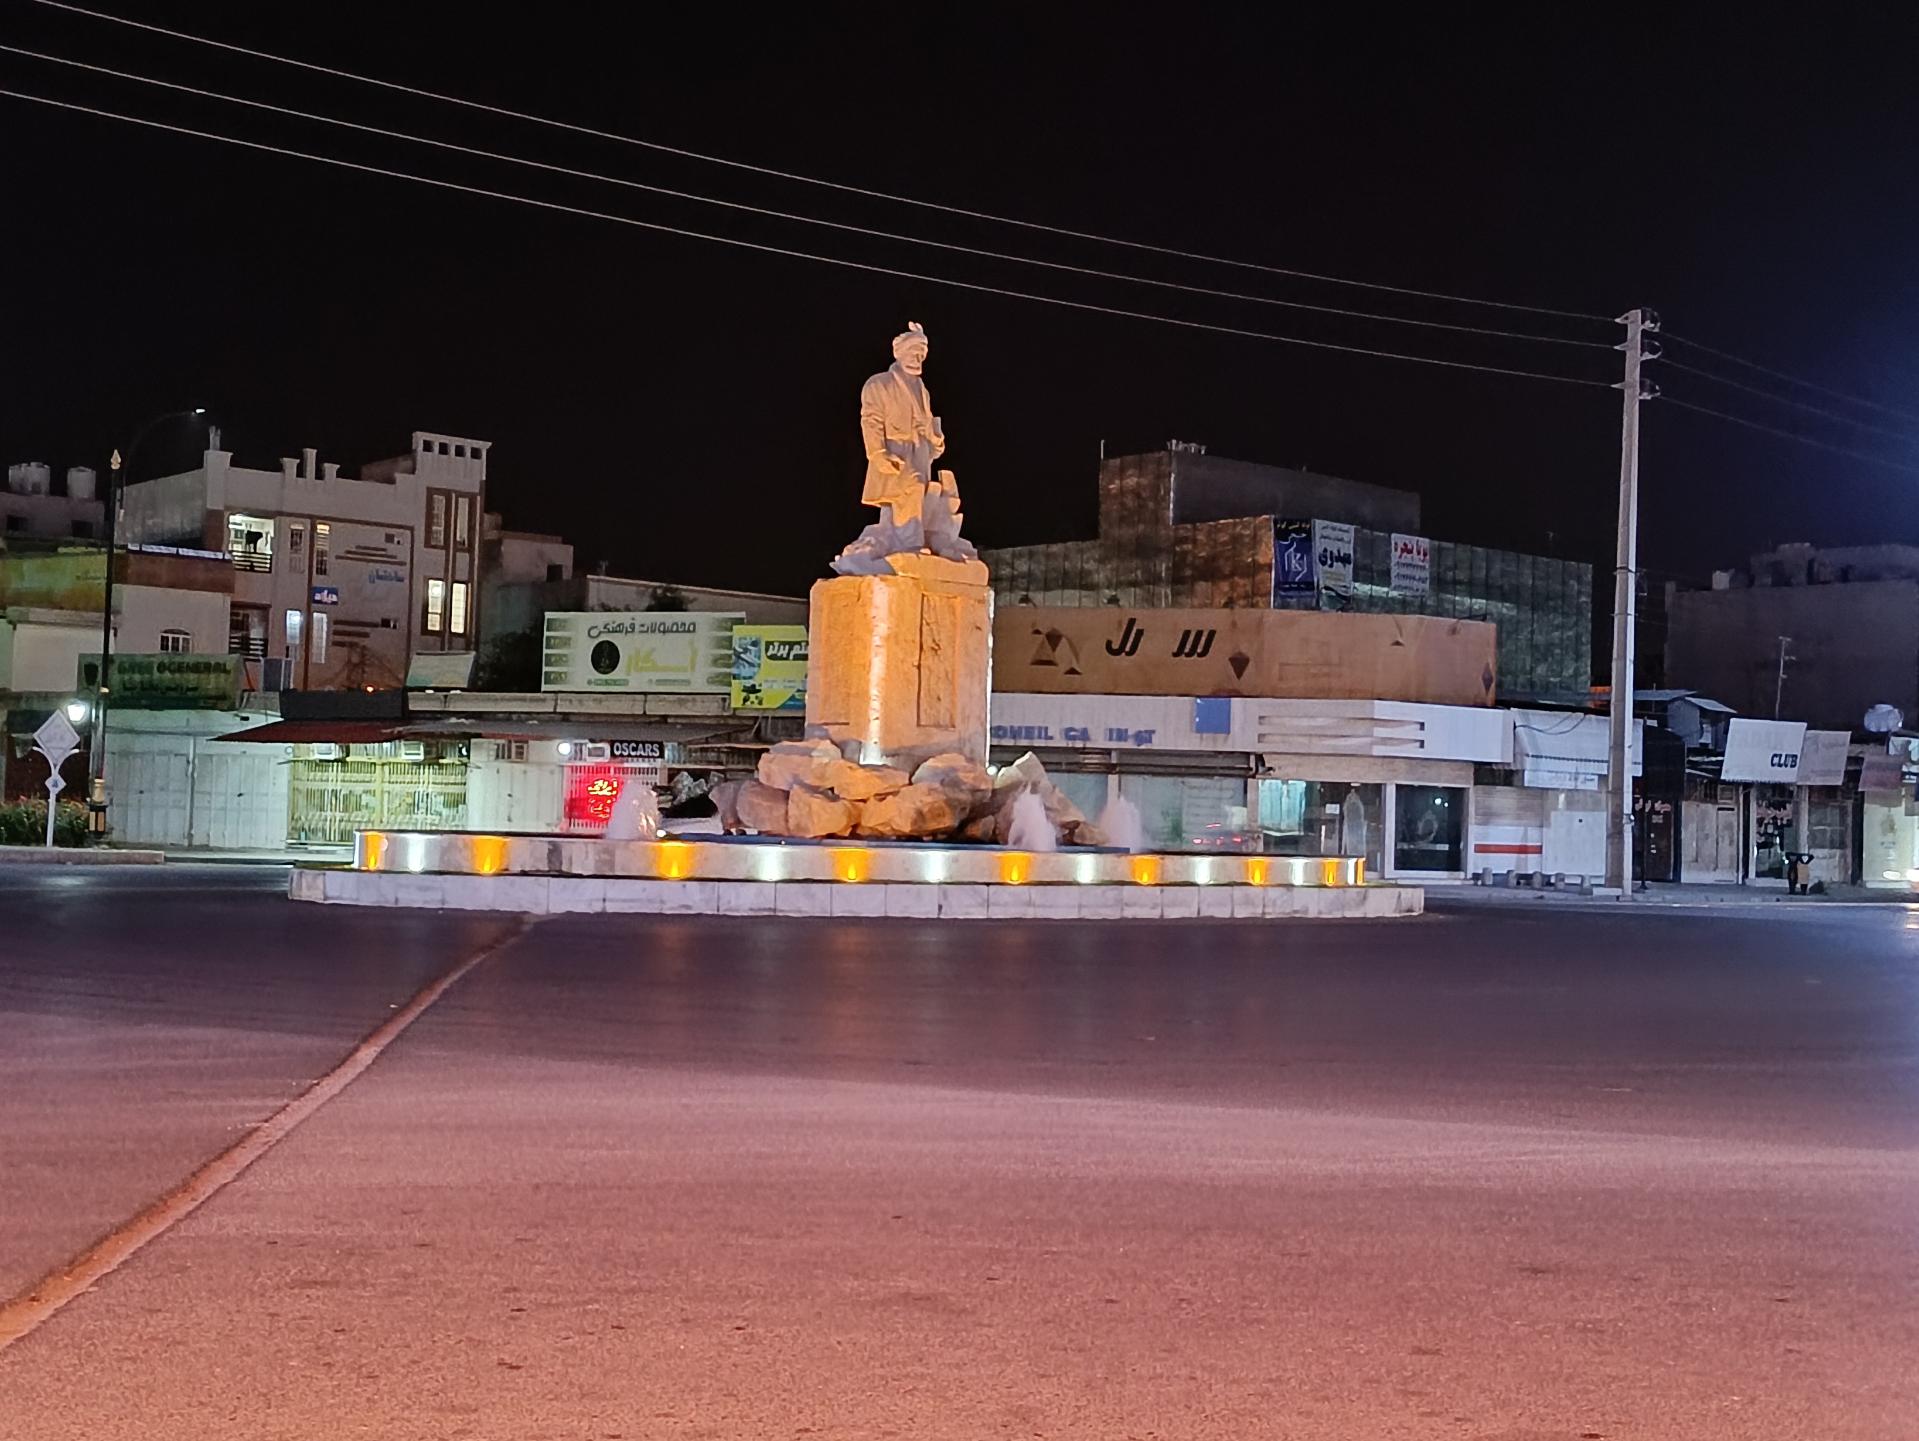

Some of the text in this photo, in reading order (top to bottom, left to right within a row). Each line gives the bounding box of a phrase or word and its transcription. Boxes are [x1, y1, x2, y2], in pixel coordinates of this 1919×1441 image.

[638, 621, 697, 635] محصولات
[613, 742, 660, 757] OSCARS
[1770, 753, 1798, 768] CLUB
